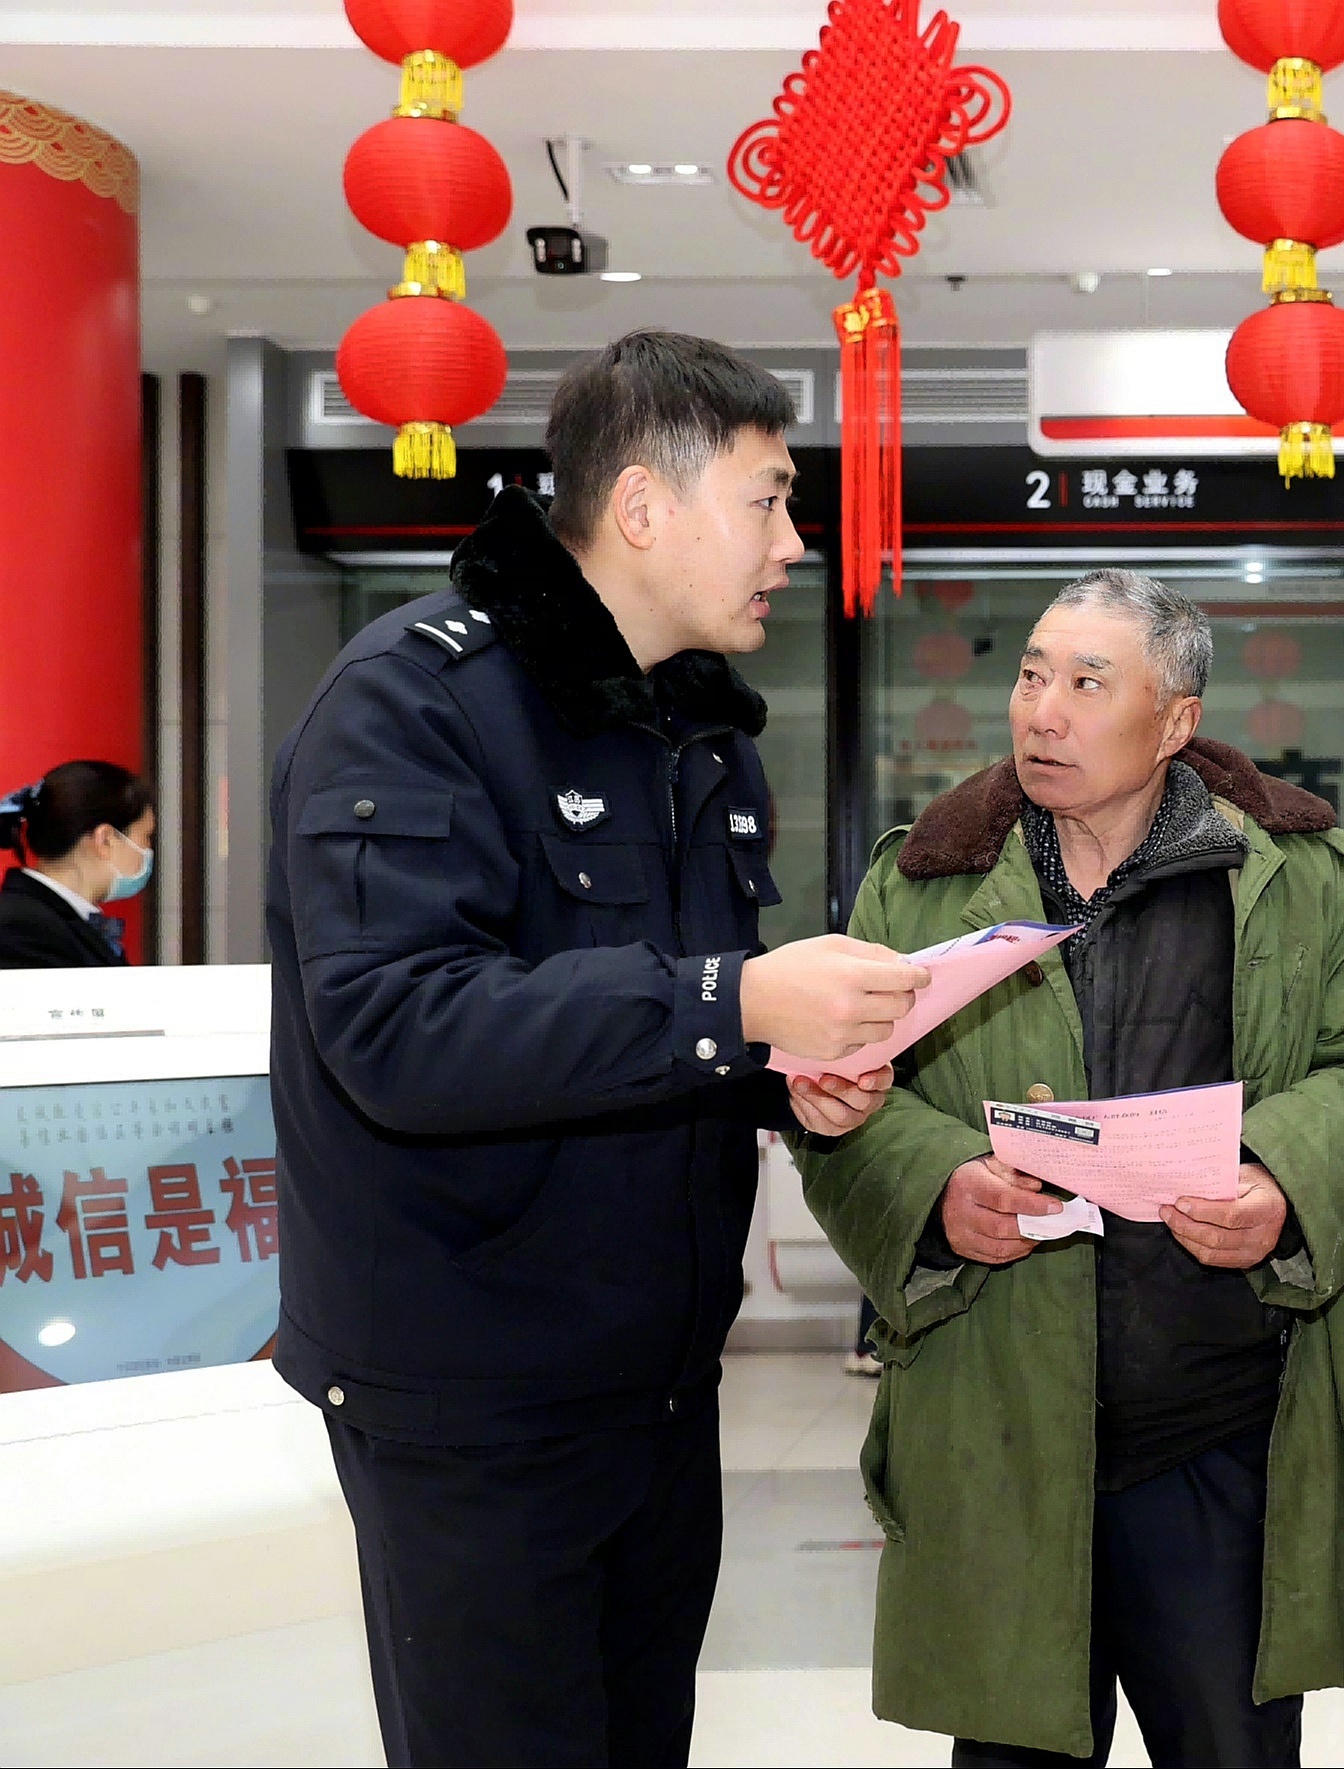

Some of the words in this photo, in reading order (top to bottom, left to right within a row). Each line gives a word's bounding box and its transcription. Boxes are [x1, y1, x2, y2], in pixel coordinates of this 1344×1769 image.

[1025, 470, 1051, 509] 2
[1081, 468, 1199, 496] 现金业务
[701, 956, 721, 1002] POLICE
